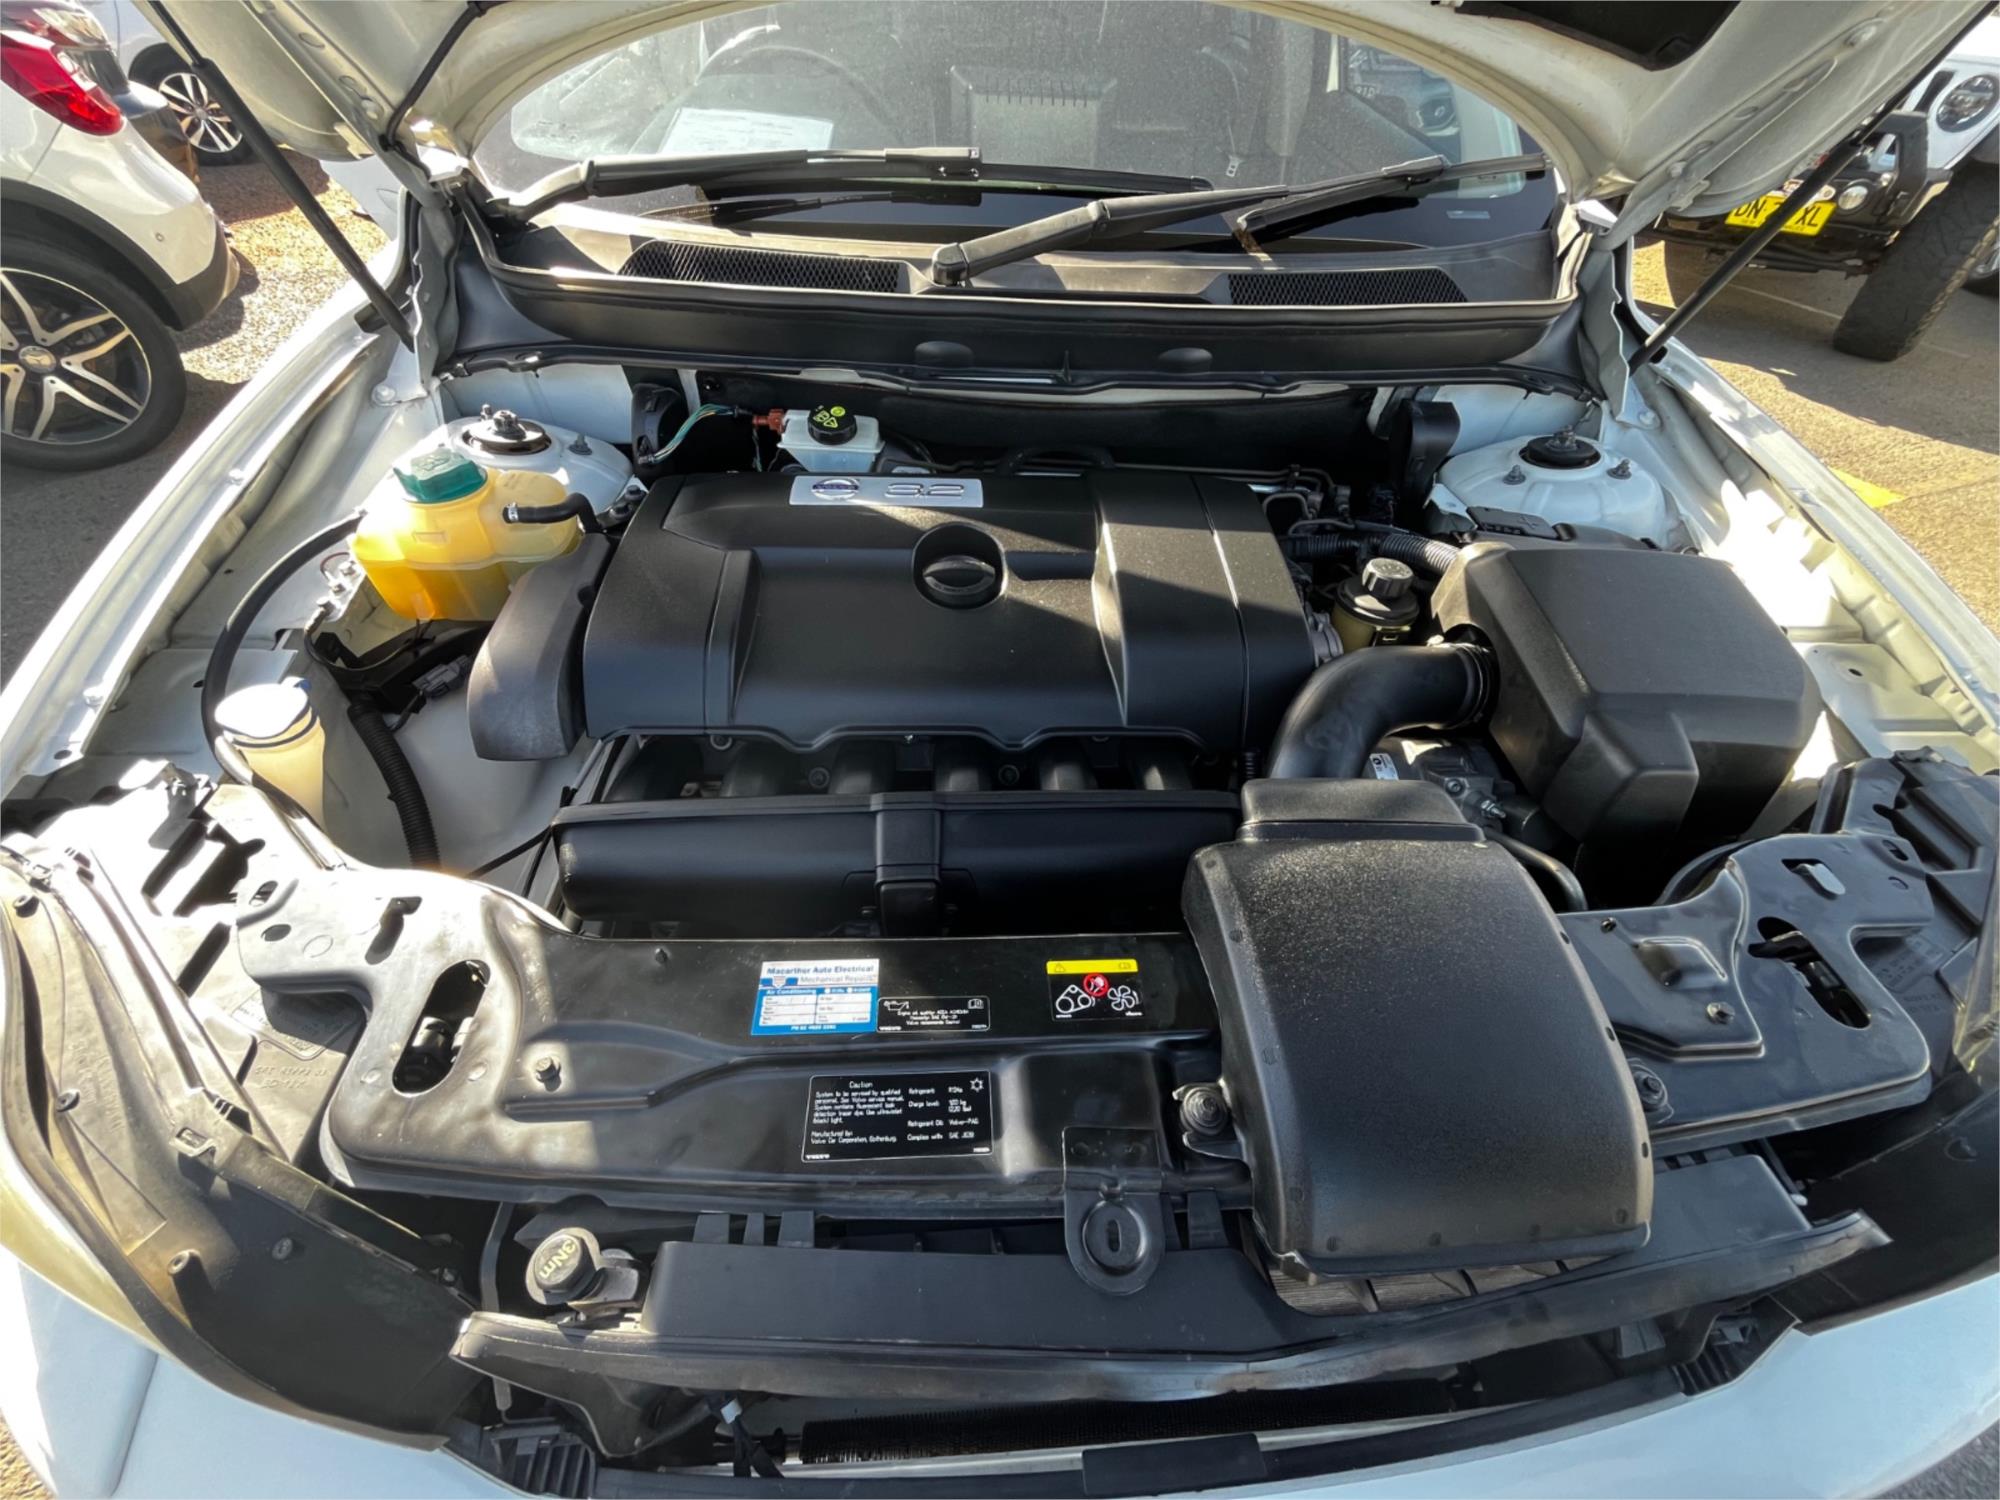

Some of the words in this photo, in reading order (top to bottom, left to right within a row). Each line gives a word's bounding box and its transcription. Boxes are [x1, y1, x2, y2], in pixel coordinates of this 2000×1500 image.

[1795, 203, 1818, 227] XL
[813, 966, 832, 974] Auto
[834, 965, 875, 973] Electrical
[800, 975, 844, 983] Mechanical
[849, 1081, 873, 1089] Caution
